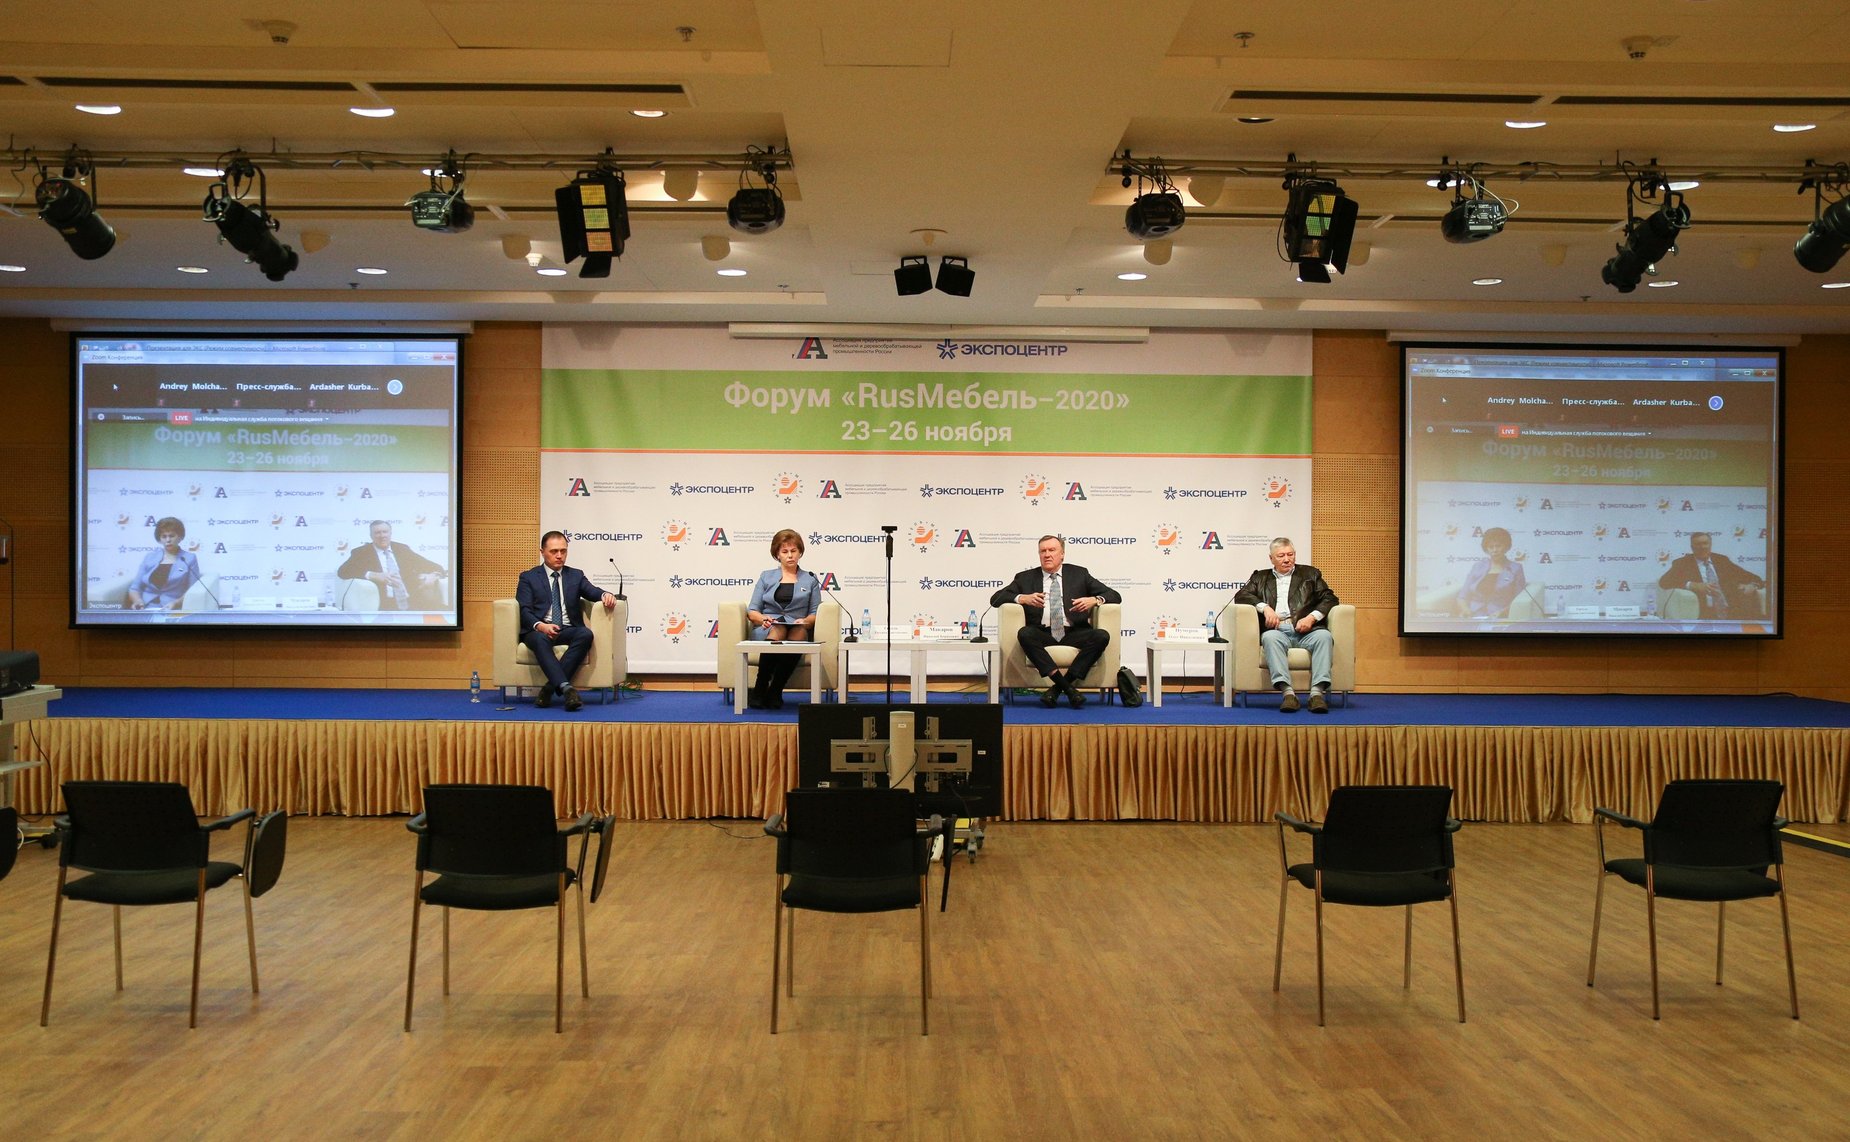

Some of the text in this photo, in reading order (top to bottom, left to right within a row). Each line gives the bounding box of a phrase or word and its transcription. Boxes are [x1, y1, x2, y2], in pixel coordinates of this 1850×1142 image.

[960, 344, 1068, 357] ЭКСПОЦЕНТР
[159, 383, 188, 391] Andrey
[236, 383, 302, 392] Пресс-служба...
[723, 381, 831, 414] Форум
[1487, 397, 1553, 405] Andrey Molcha...
[1562, 398, 1625, 407] Пресс-служба...
[154, 426, 222, 446] Форум
[925, 420, 1012, 447] ноября
[1482, 439, 1547, 459] Форум
[277, 452, 329, 466] ноября
[1601, 466, 1651, 480] ноября
[685, 485, 754, 494] ЭКСПОЦЕНТР
[935, 487, 1004, 496] ЭКСПОЦЕНТР
[1179, 489, 1247, 498] ЭКСПОЦЕНТР
[574, 532, 643, 541] ЭКСПОЦЕНТР
[824, 534, 886, 543] ЭКСПОЦЕНТ
[1068, 537, 1137, 545] ЭКСПОЦЕНТР
[684, 578, 754, 587] ЭКСПОЦЕНТР
[935, 580, 1004, 588] ЭКСПОЦЕНТР
[1178, 582, 1246, 590] ЭКСПОЦЕНТР
